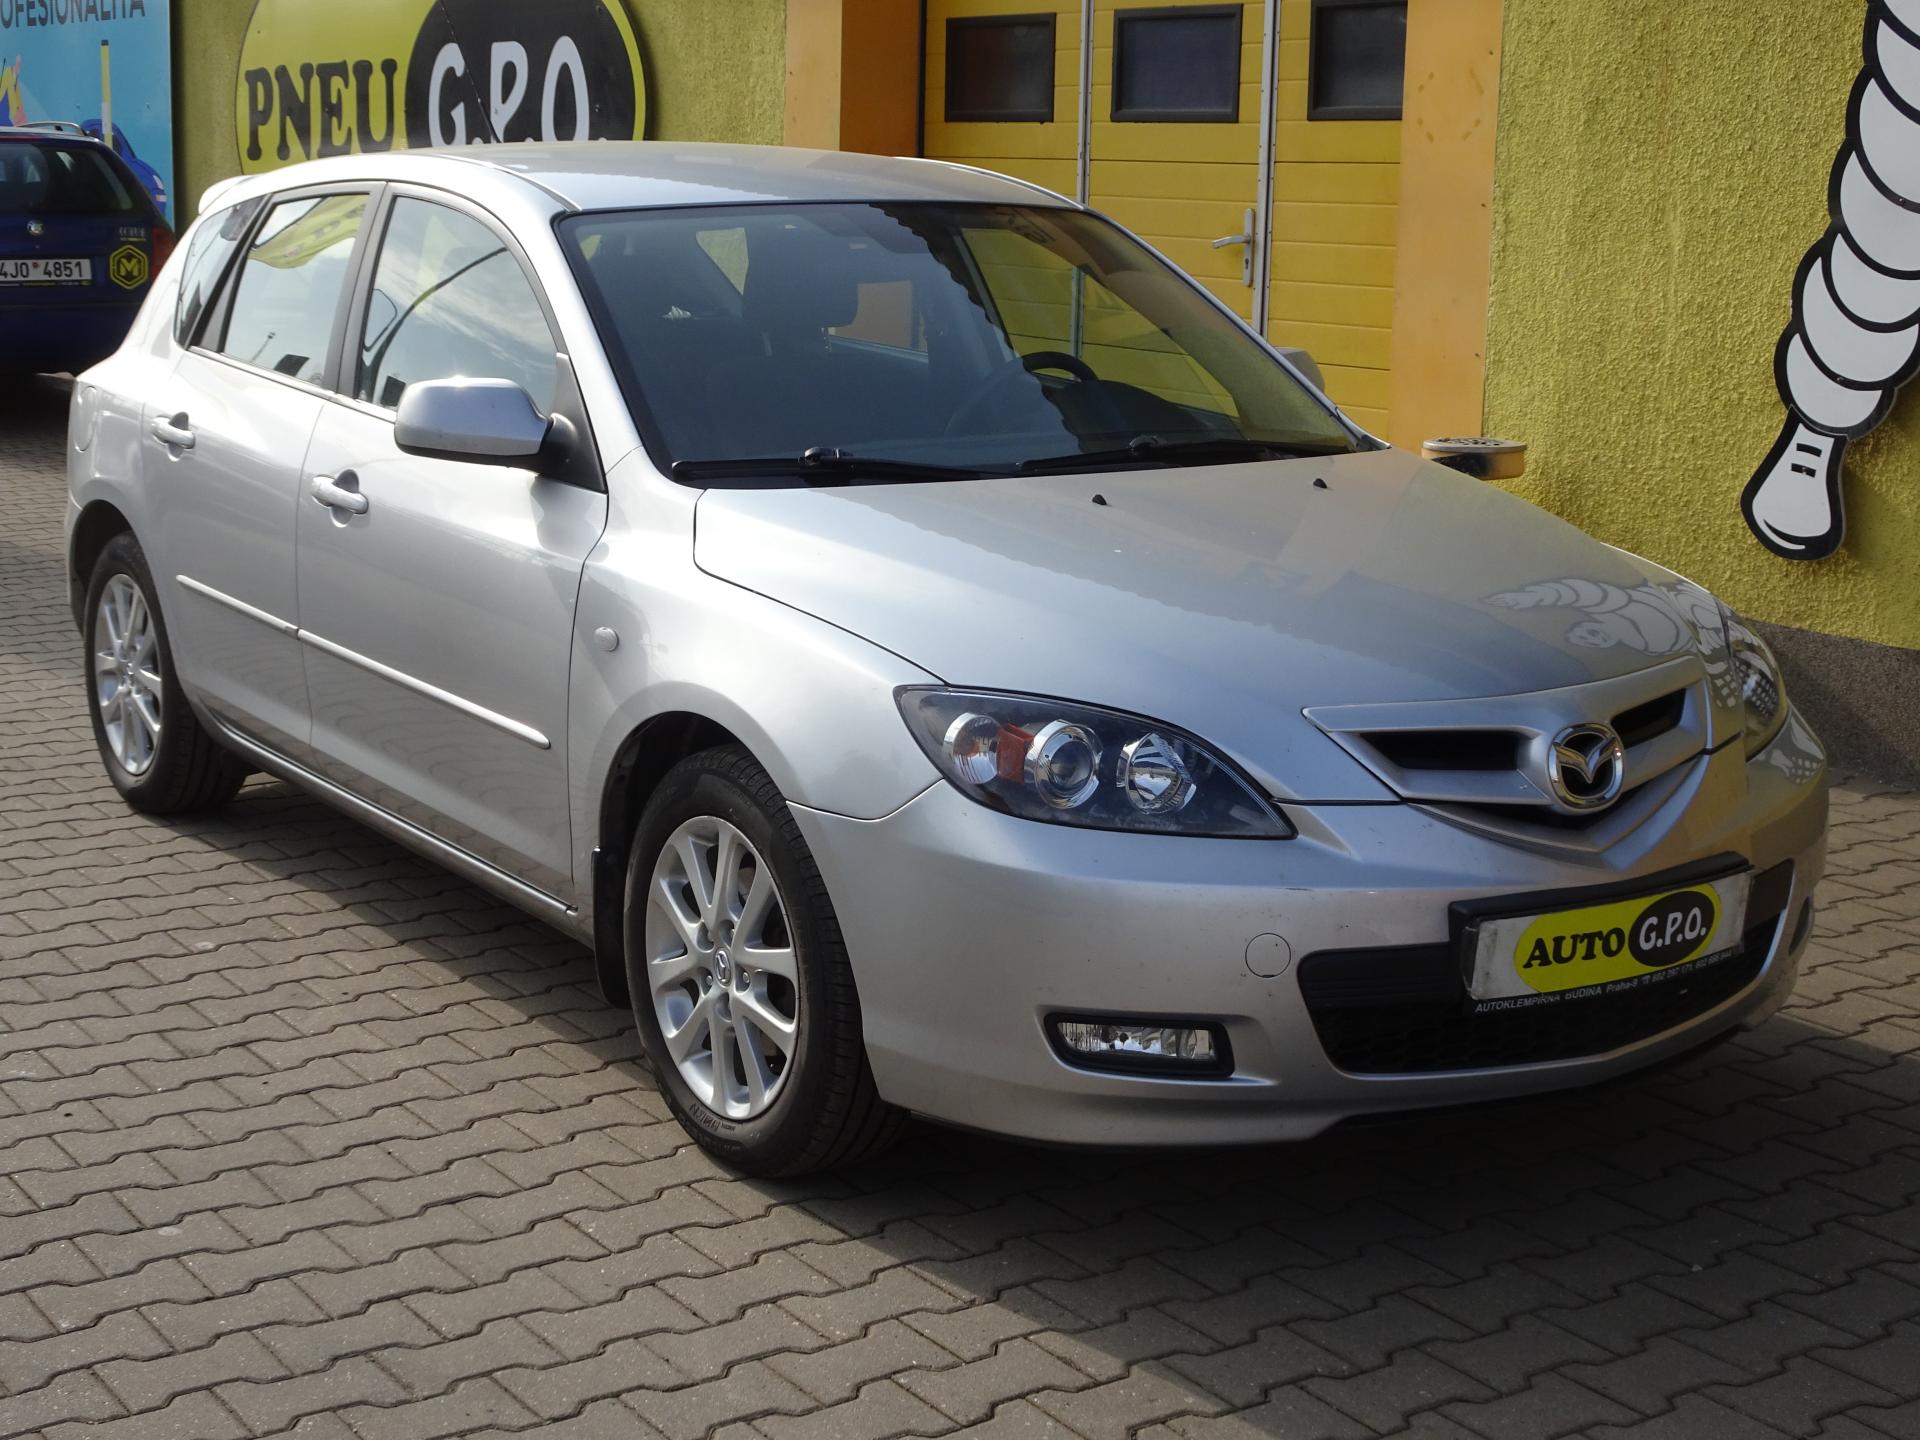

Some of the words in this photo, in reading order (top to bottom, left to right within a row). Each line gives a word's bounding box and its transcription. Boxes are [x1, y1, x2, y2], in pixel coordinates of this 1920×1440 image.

[244, 58, 398, 161] PNEU
[43, 261, 83, 278] 4851
[1522, 926, 1626, 969] AUTO
[1638, 906, 1707, 951] G.P.O.
